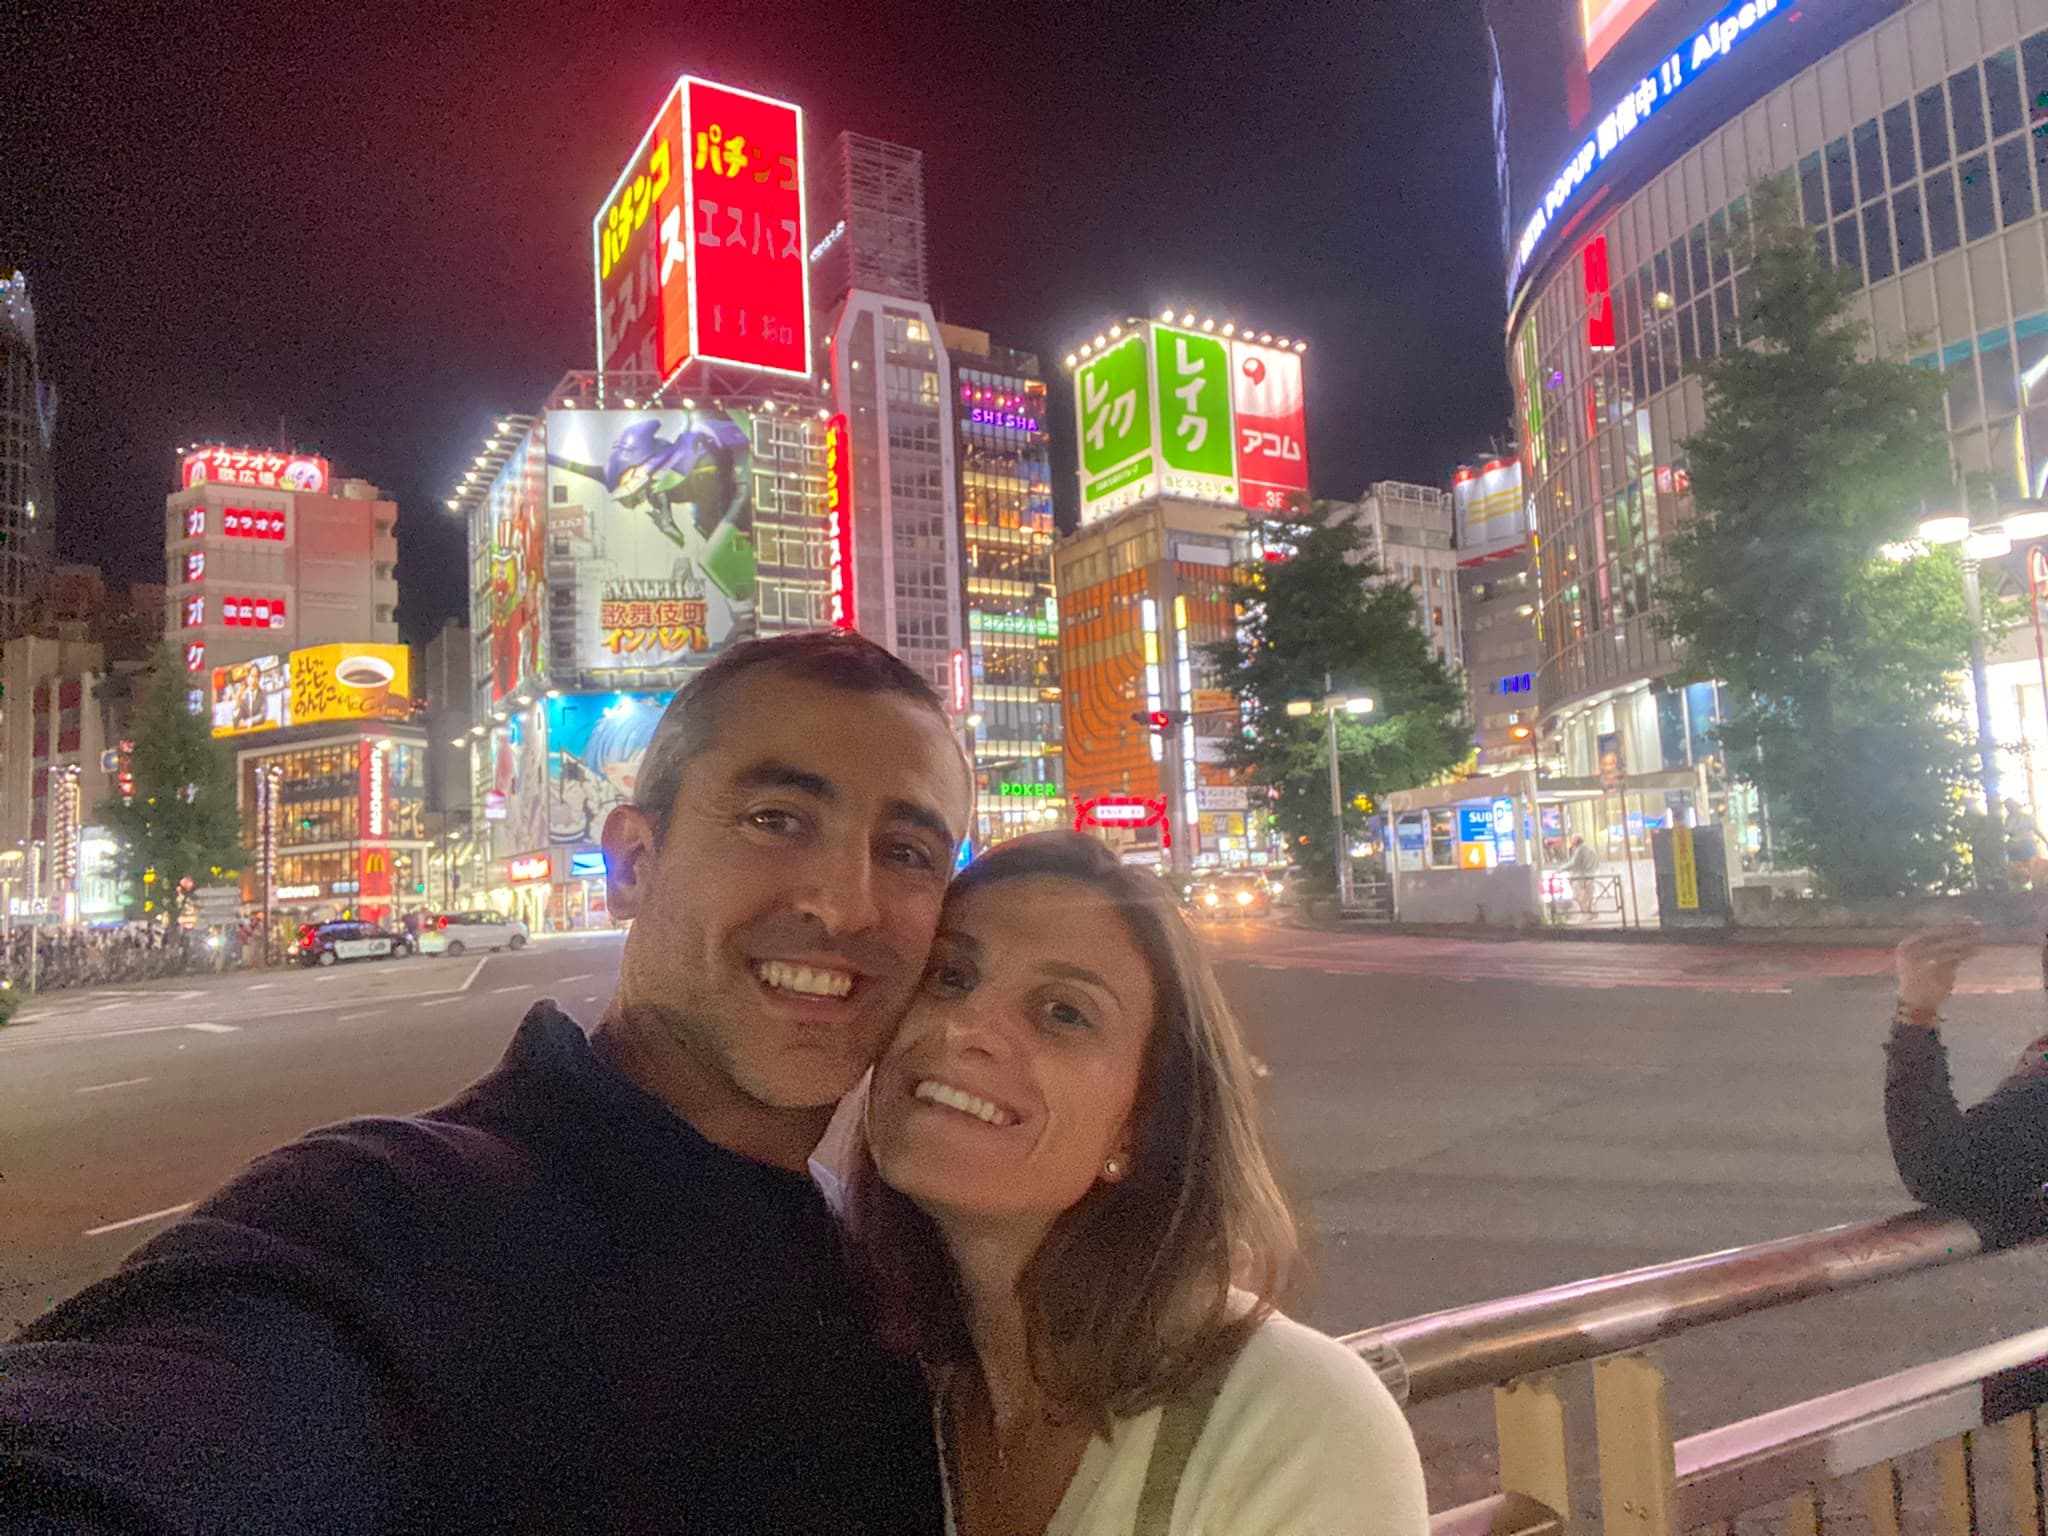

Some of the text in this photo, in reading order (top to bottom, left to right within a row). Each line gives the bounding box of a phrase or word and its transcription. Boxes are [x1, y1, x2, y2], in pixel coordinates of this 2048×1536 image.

[695, 123, 799, 192] パチンコ
[602, 136, 670, 281] パチンコ
[1175, 338, 1208, 452] レイク
[972, 408, 1040, 432] SHISHA
[1241, 429, 1301, 461] アコム
[212, 448, 285, 472] カラオケ
[1265, 491, 1284, 508] 3F
[224, 516, 285, 532] カラオケ
[601, 601, 708, 627] 歌舞伎町
[601, 627, 709, 655] インパクト
[1000, 782, 1056, 797] POKER
